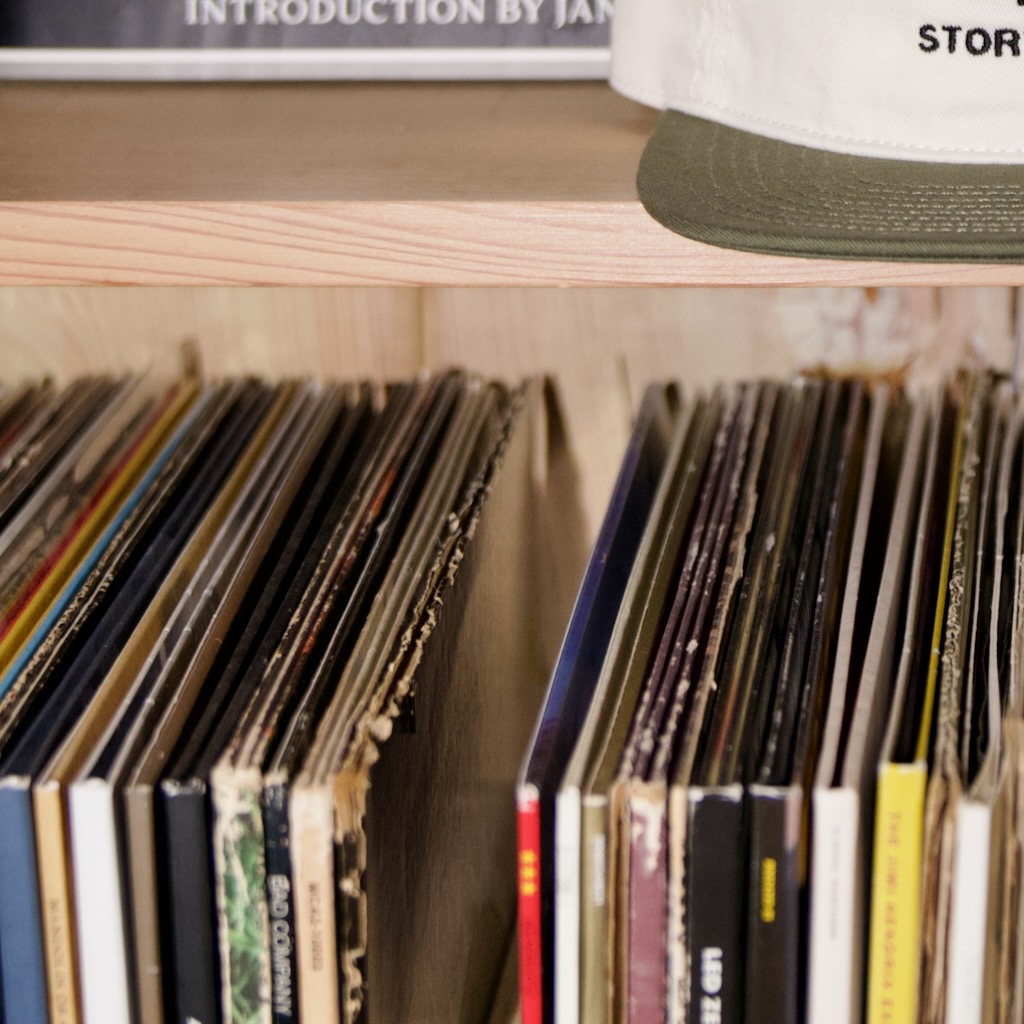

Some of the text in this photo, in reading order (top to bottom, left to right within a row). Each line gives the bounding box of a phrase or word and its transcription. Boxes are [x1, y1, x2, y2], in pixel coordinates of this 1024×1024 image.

[267, 876, 292, 1017] BAD COMPANY
[701, 947, 723, 995] LED
